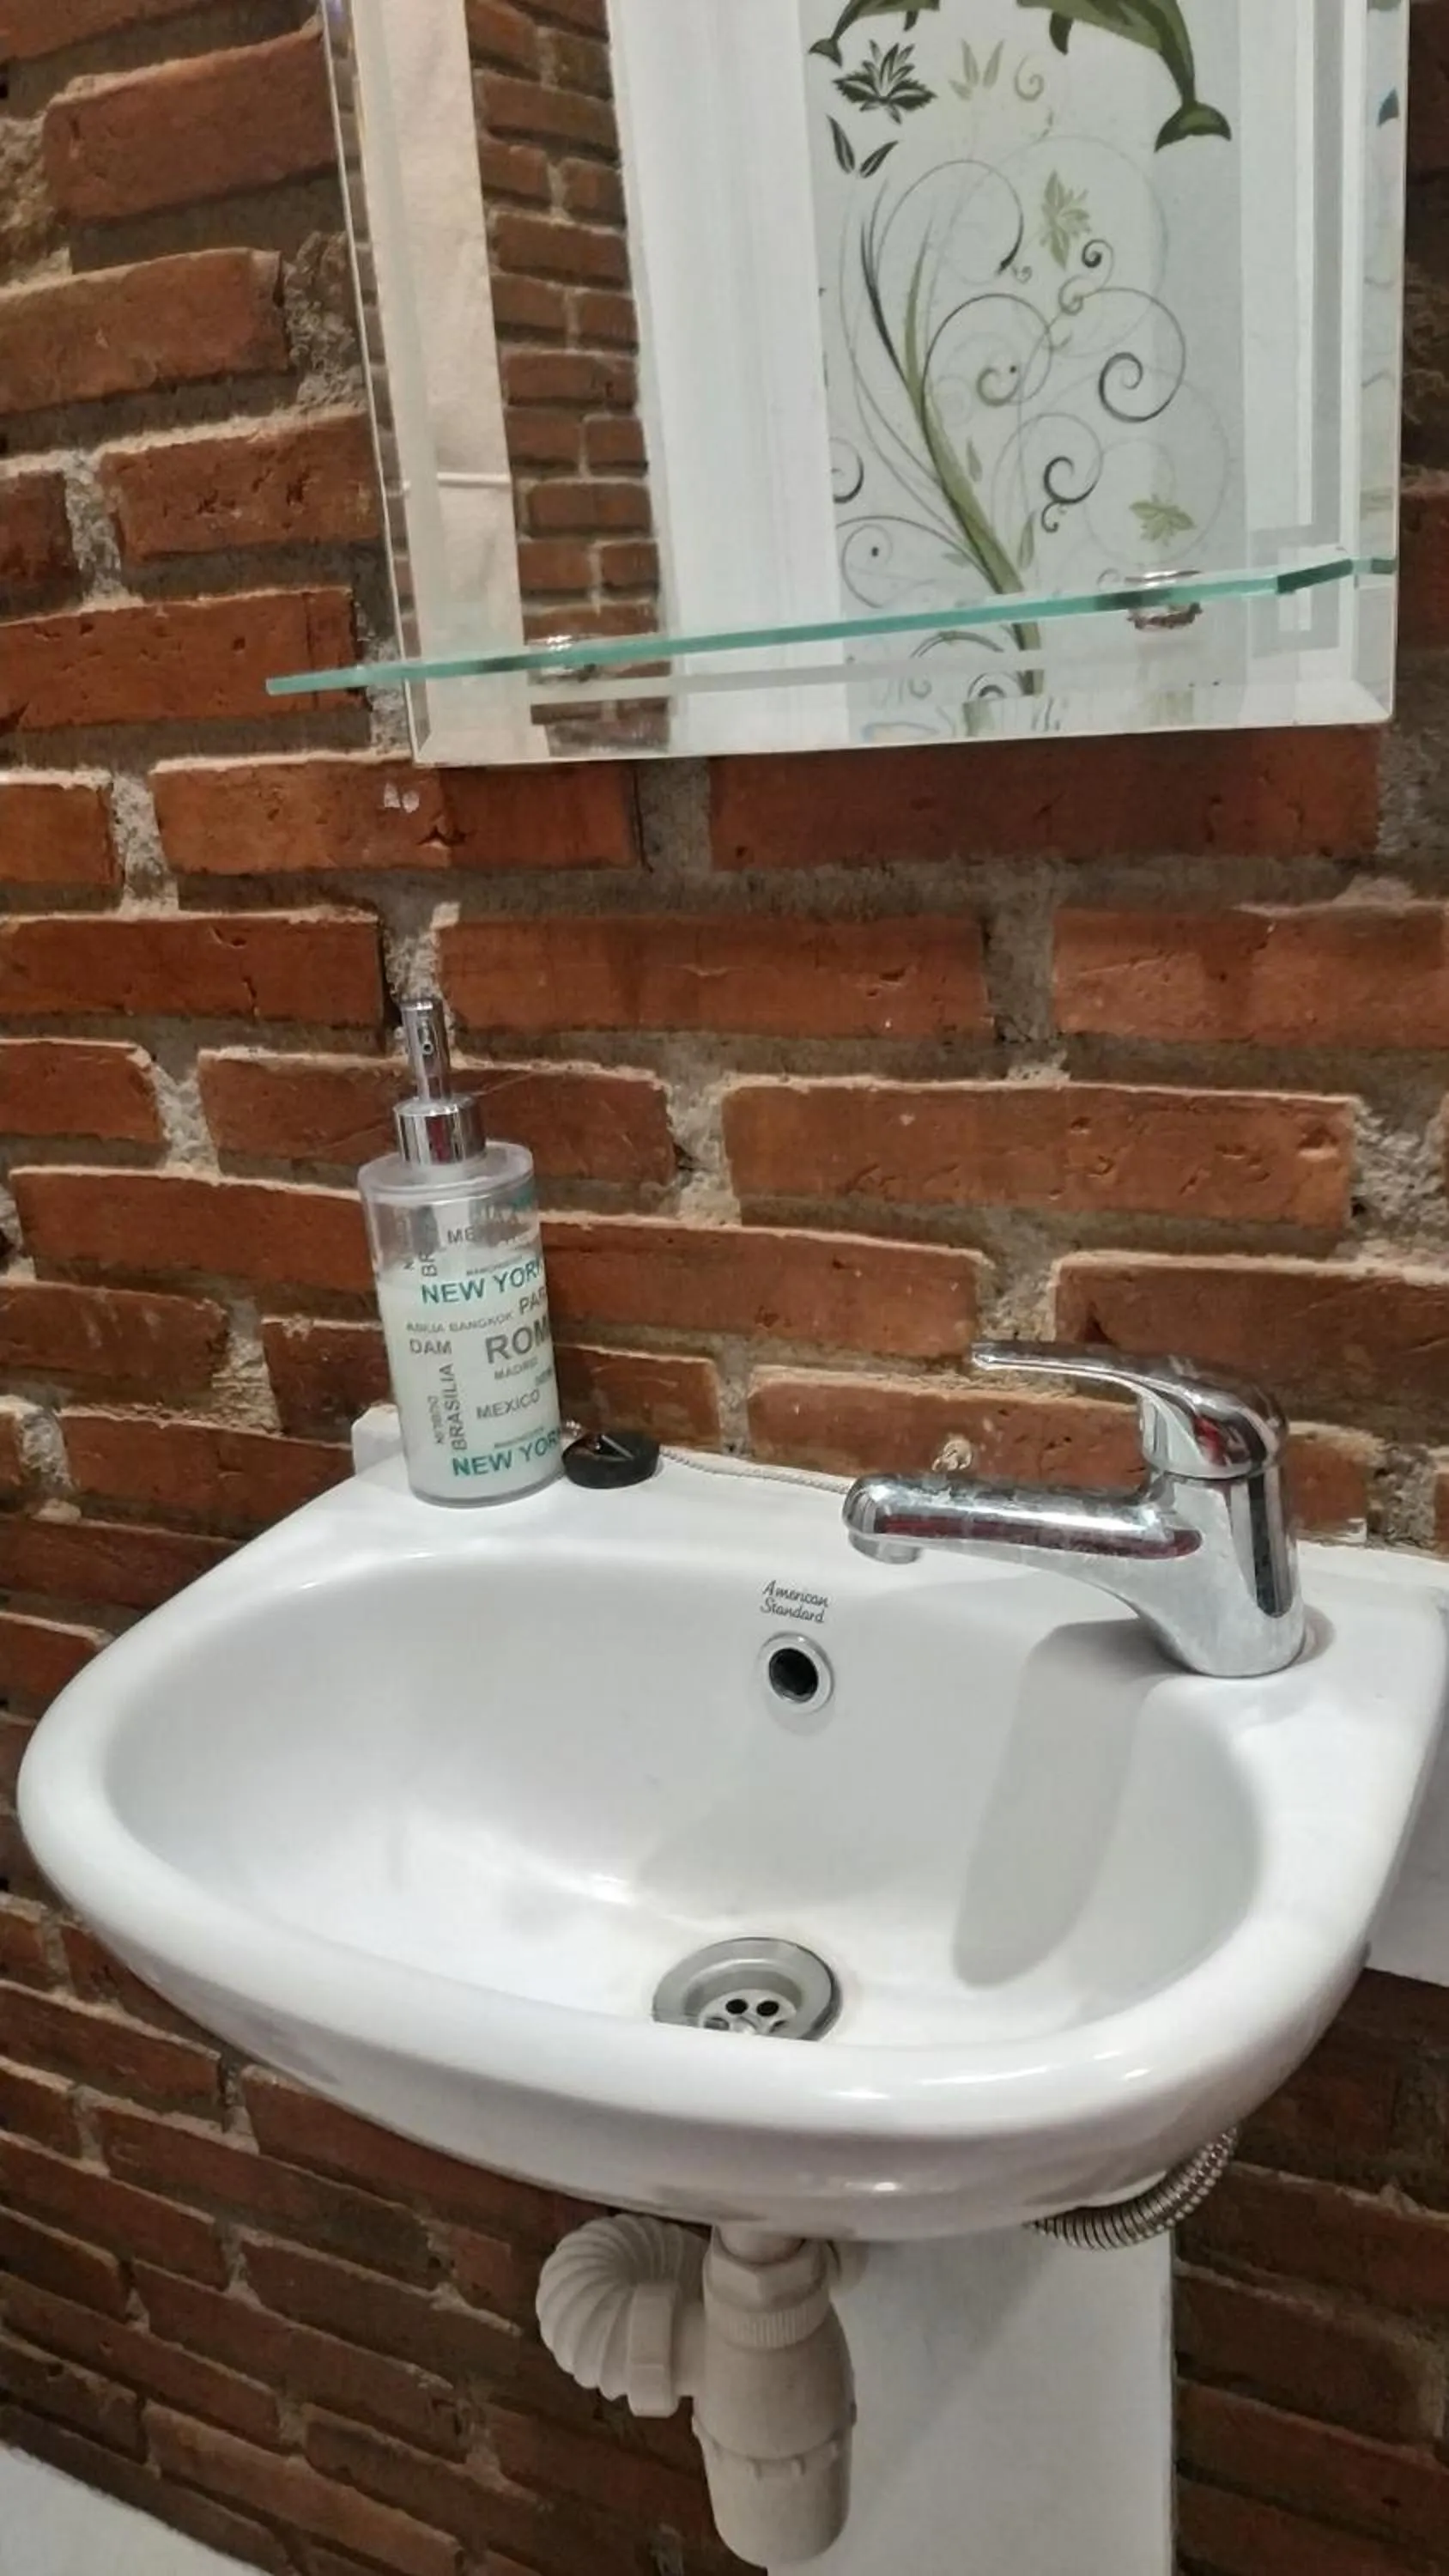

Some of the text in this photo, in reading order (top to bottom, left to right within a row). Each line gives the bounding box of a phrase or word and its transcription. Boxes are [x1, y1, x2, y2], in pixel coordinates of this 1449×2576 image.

[421, 1278, 485, 1304] NEW
[449, 1311, 513, 1332] BANGKOK
[409, 1338, 452, 1355] DAM
[440, 1363, 468, 1451] BRASILIA
[476, 1388, 541, 1419] MEXICO
[452, 1449, 512, 1477] NEW
[762, 1579, 828, 1608] American
[760, 1596, 825, 1624] Standard
